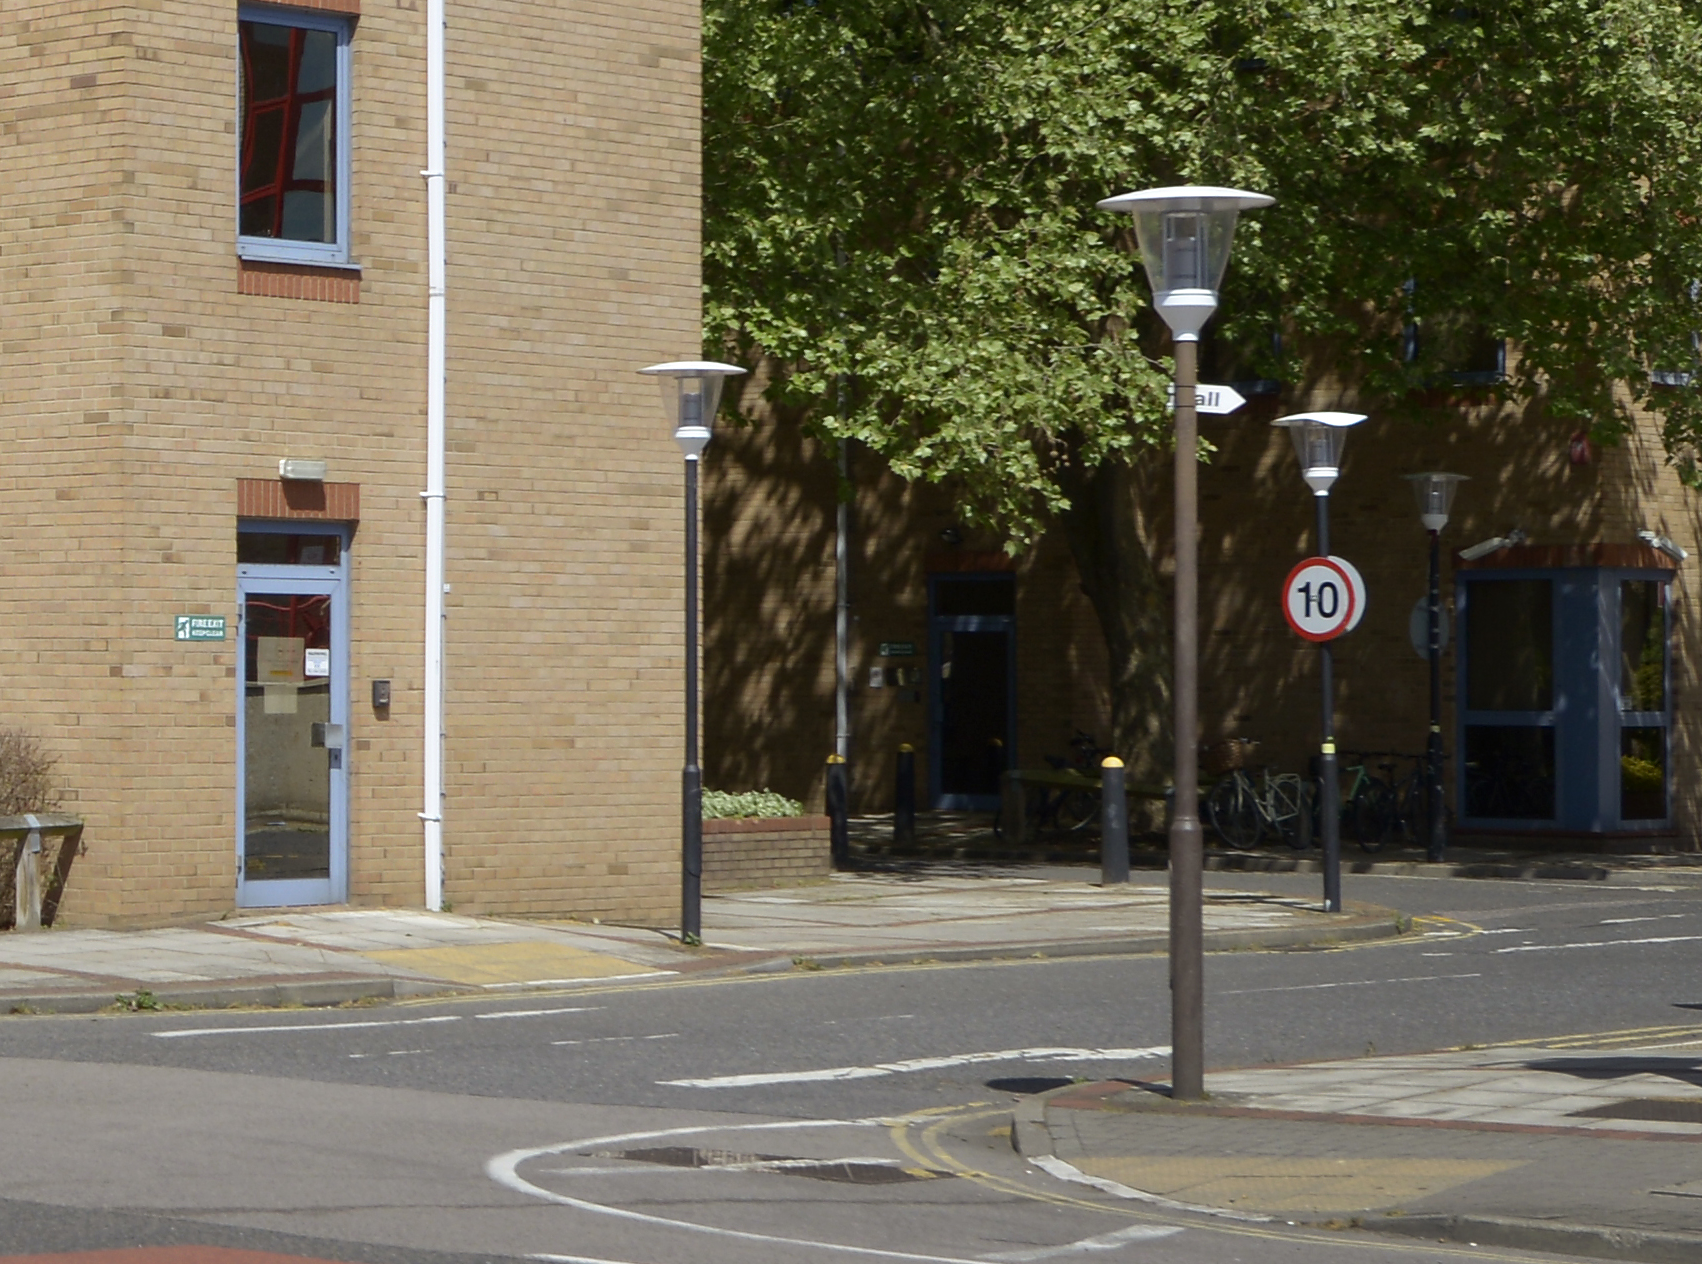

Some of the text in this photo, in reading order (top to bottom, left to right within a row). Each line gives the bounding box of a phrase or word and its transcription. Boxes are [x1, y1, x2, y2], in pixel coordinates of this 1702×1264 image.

[1194, 391, 1220, 407] all
[1297, 581, 1339, 618] 10
[191, 618, 224, 628] FIRE EXIT
